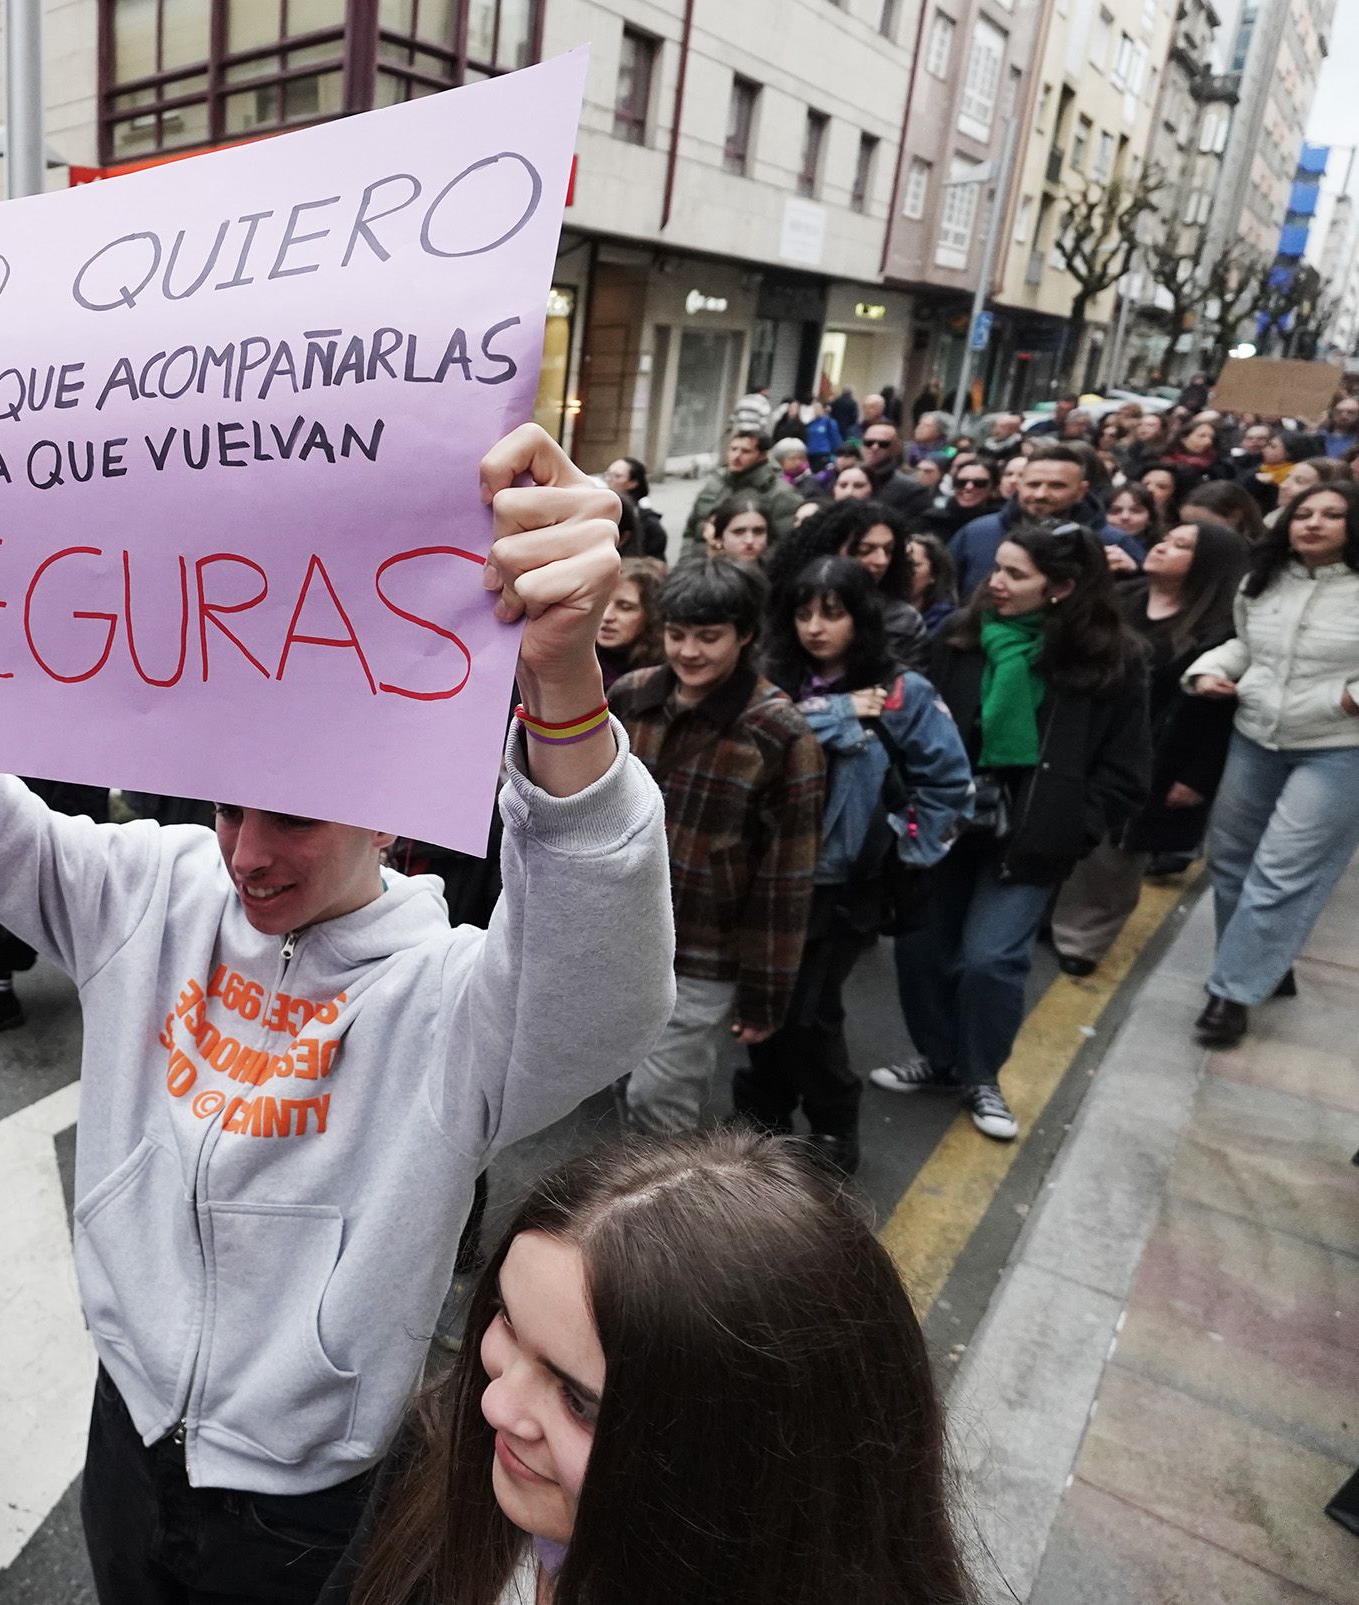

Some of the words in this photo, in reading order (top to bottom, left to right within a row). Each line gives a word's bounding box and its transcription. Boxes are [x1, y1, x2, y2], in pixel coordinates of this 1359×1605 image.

[73, 152, 542, 311] QUIERO
[95, 316, 520, 411] ACOMPAÑARLAS
[27, 438, 127, 490] QUE
[145, 418, 385, 471] VUELVAN
